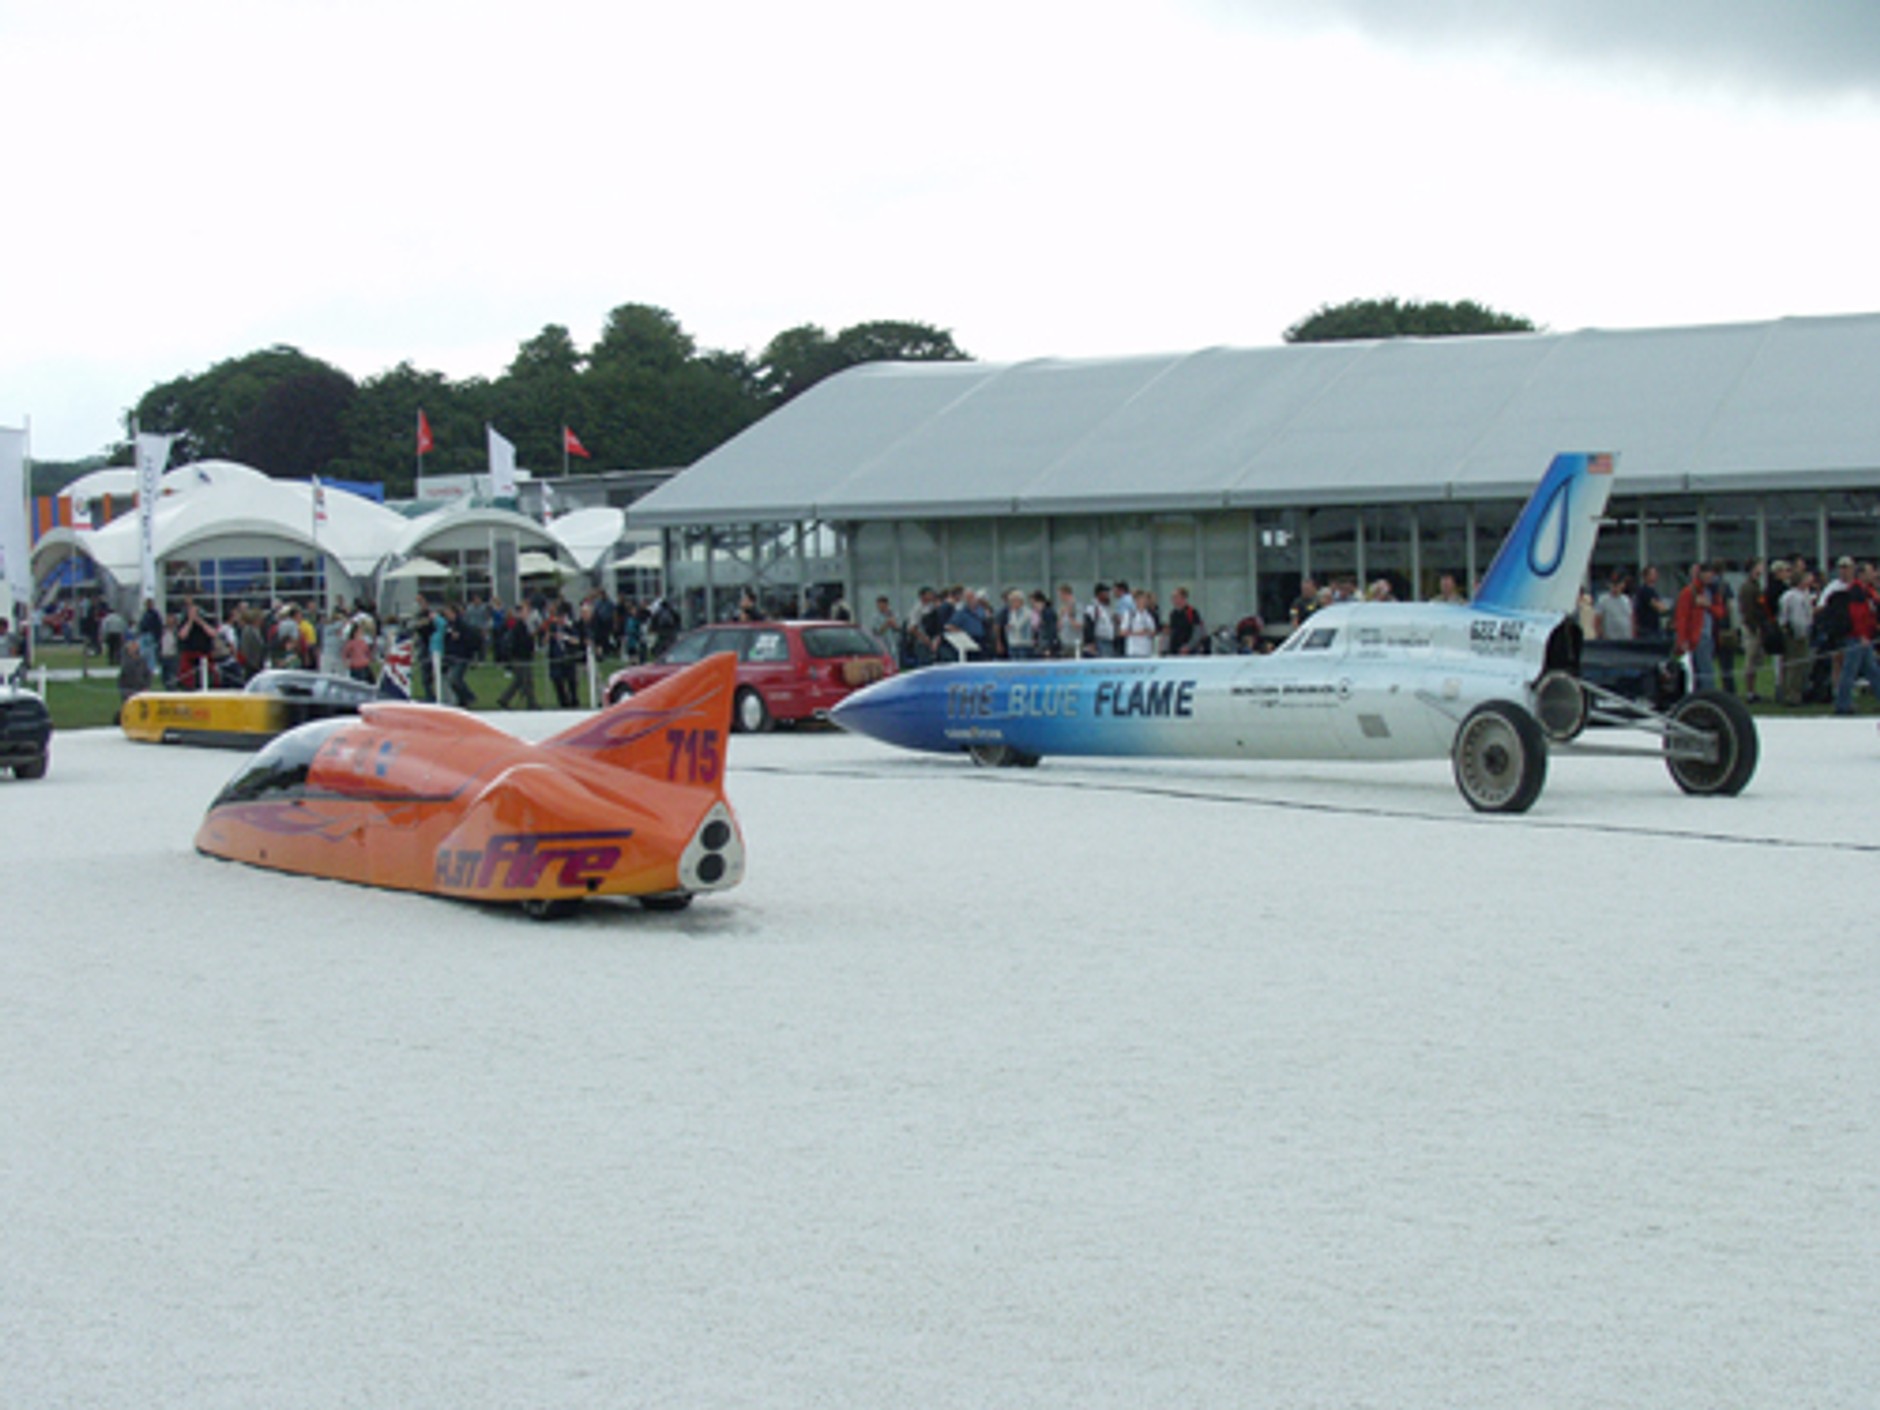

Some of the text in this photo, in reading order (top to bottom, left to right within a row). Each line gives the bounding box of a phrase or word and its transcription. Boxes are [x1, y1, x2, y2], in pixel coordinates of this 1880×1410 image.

[945, 679, 1197, 719] THE BLUE FLAME
[666, 728, 720, 784] 715
